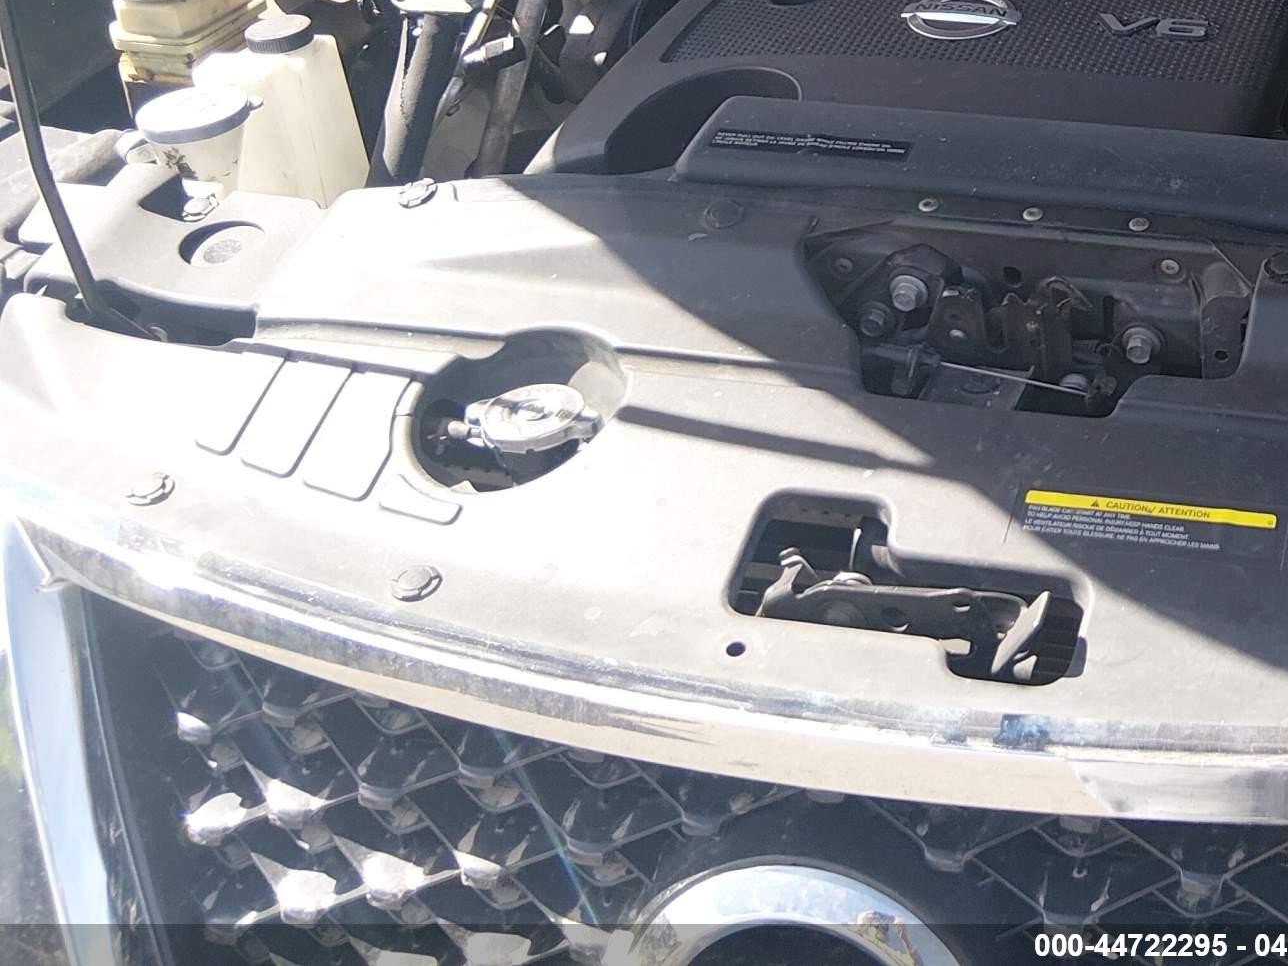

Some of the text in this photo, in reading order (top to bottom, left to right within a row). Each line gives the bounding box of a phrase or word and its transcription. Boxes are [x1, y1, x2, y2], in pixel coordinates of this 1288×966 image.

[915, 3, 1007, 17] NISSAN
[1100, 13, 1209, 37] V6
[1158, 507, 1210, 519] ATTENTION
